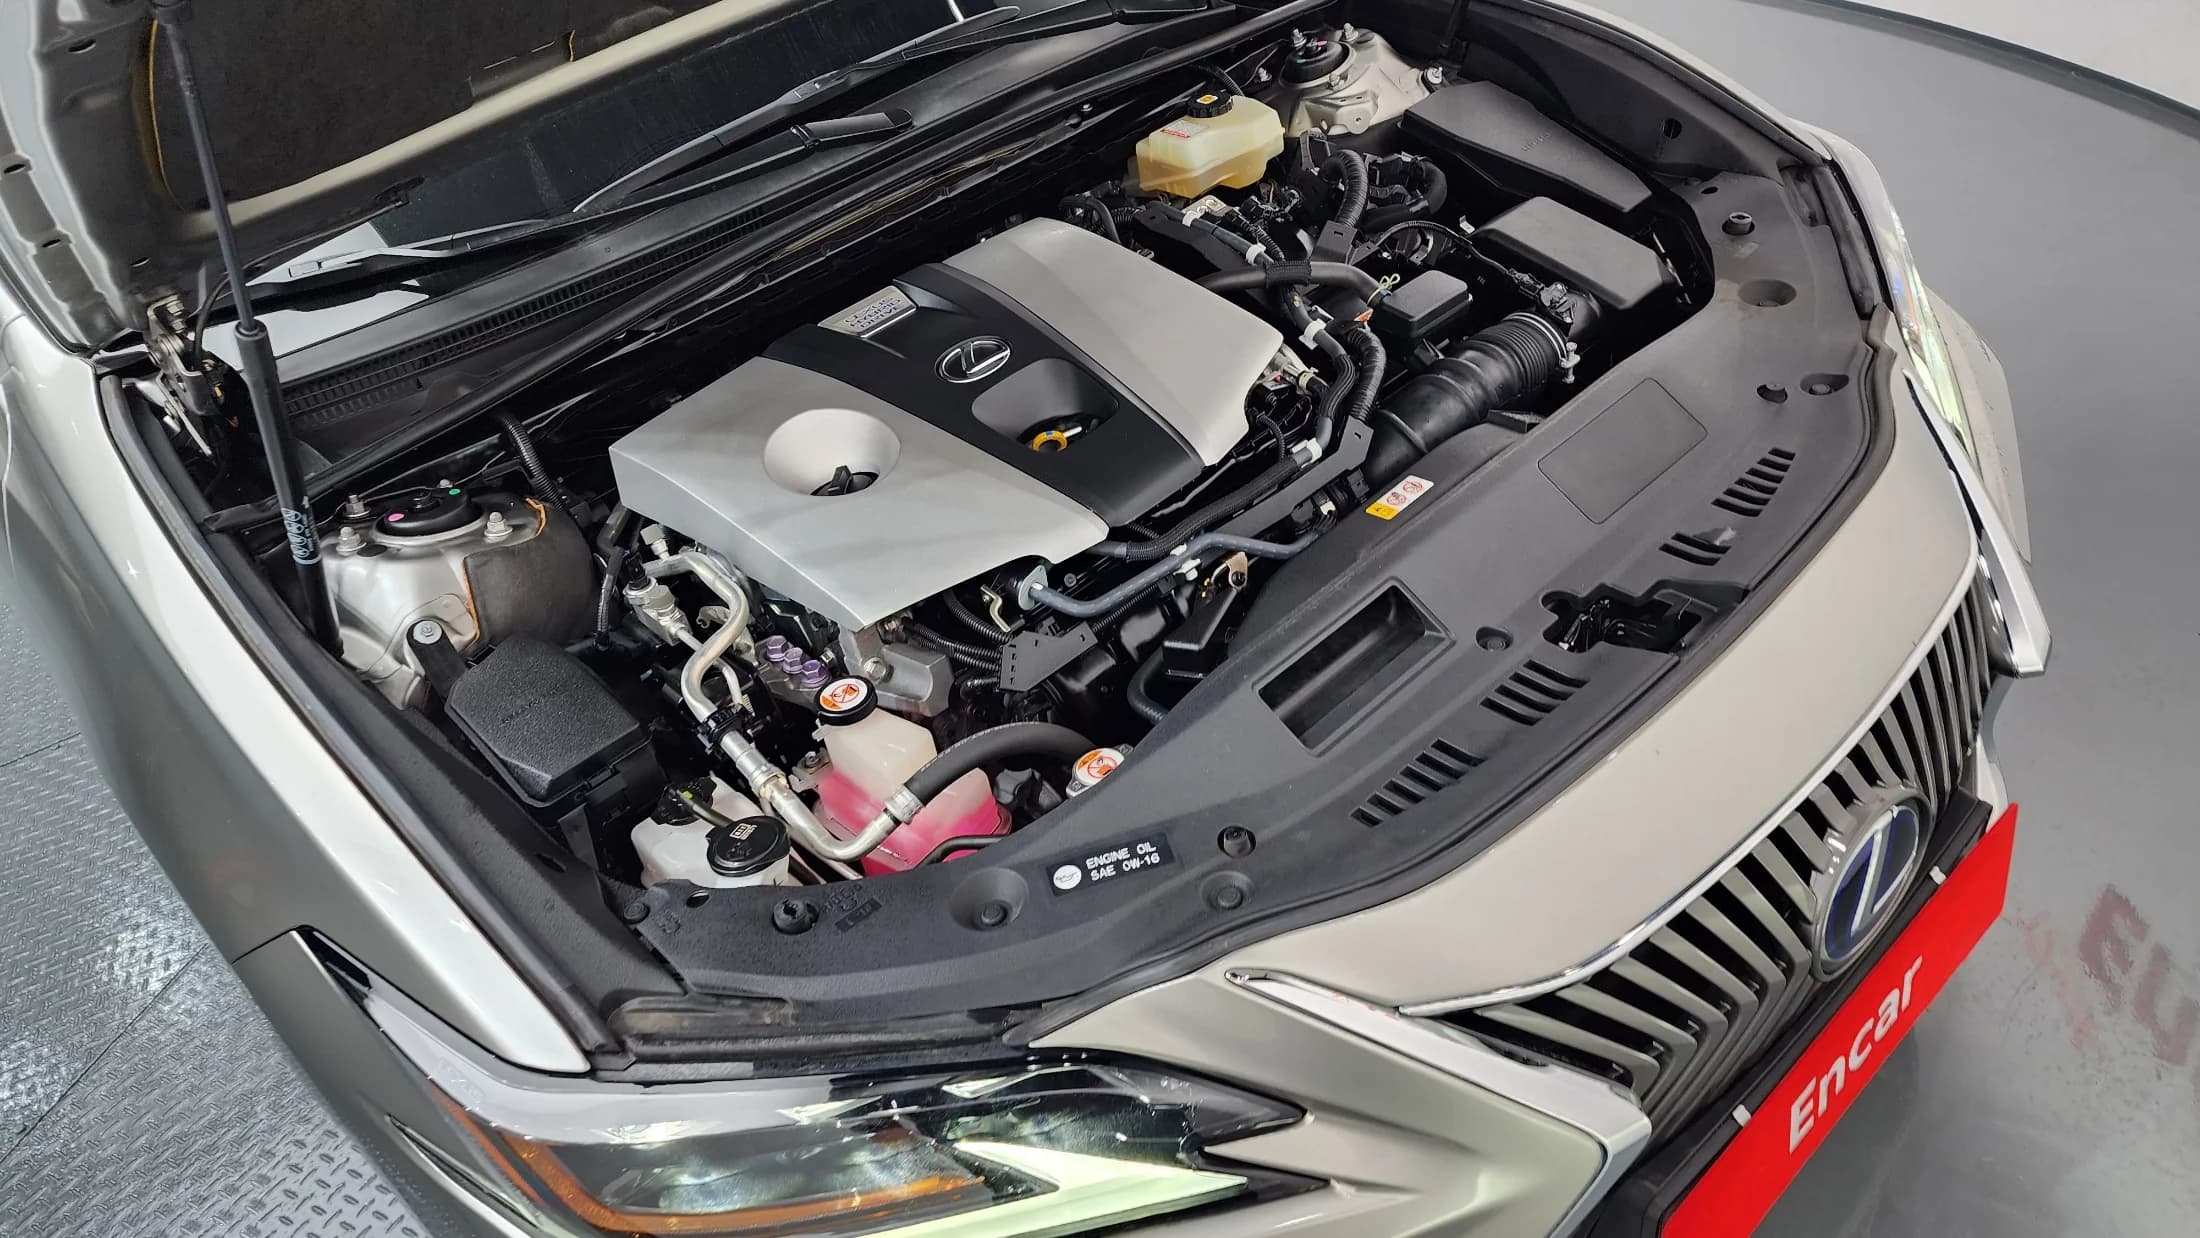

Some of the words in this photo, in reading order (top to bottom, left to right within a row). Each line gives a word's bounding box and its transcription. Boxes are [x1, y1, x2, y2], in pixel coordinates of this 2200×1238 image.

[1086, 847, 1131, 870] ENGINE
[1136, 841, 1157, 855] OIL
[1090, 864, 1117, 881] SAE
[1122, 852, 1161, 872] 0W-16
[1789, 955, 1923, 1154] Encar
